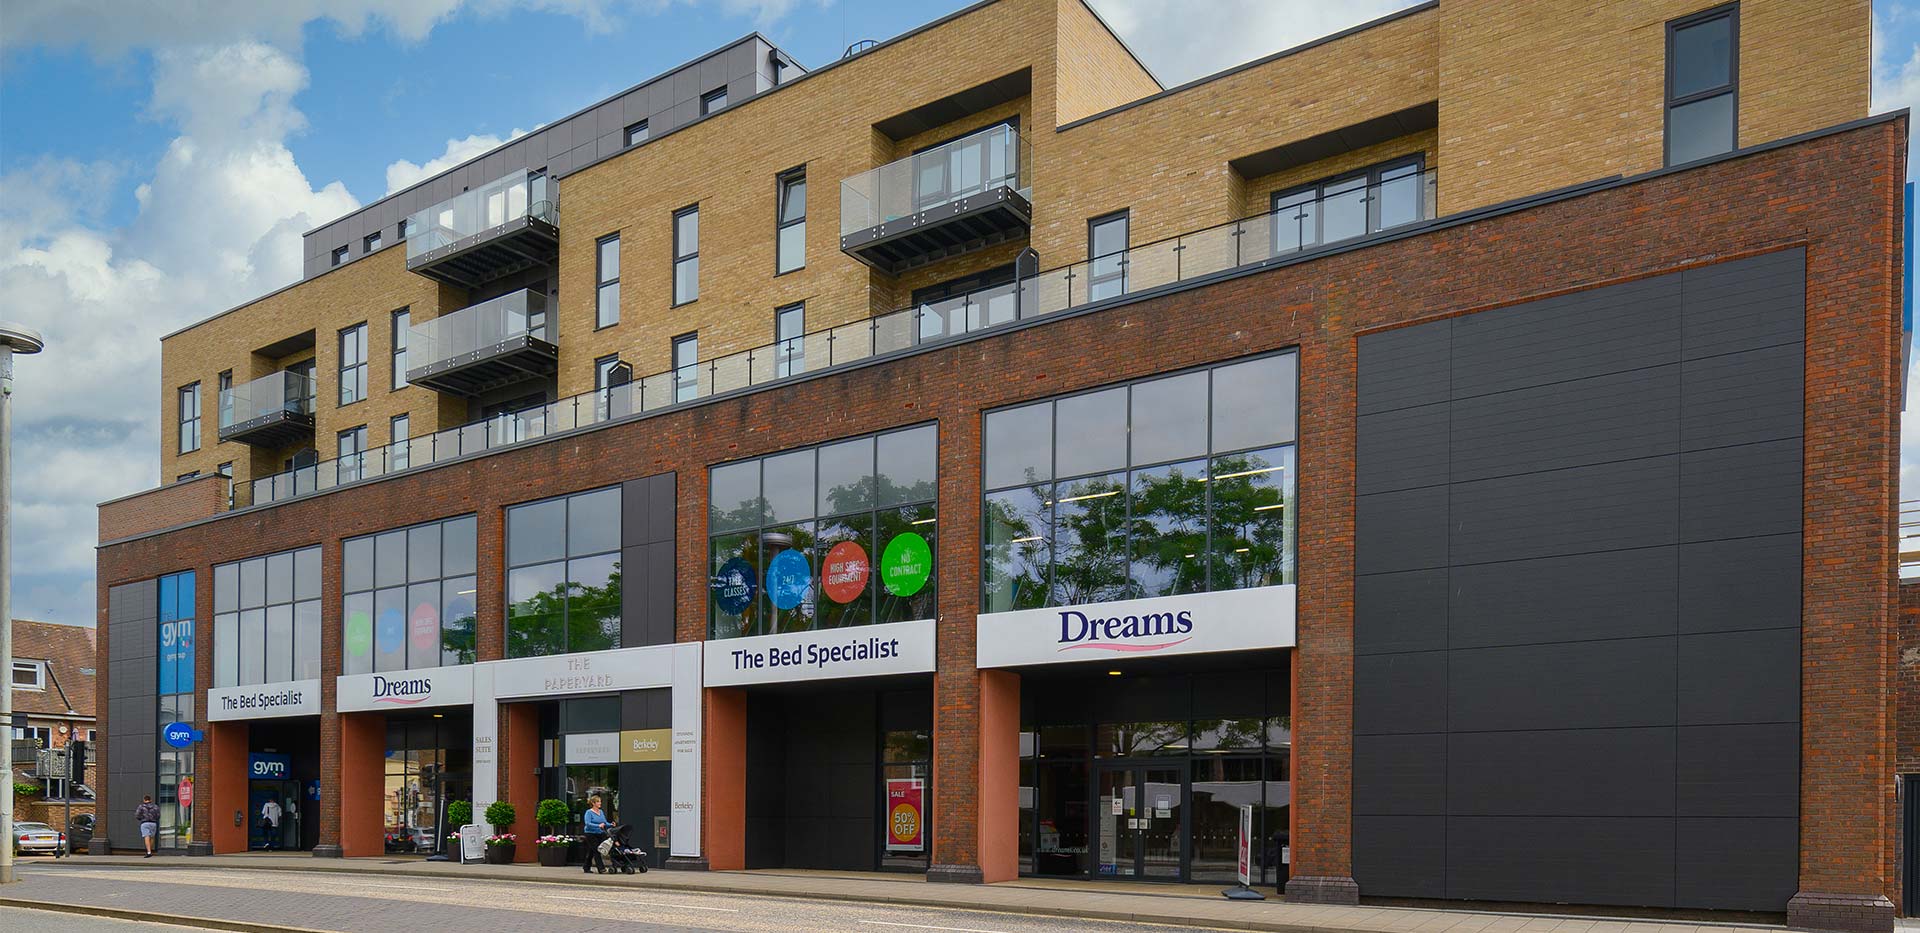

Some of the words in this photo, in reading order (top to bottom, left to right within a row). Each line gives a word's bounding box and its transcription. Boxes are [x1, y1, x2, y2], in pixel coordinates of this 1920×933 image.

[830, 562, 844, 574] HIGH
[889, 564, 922, 577] CONTRACT
[723, 586, 747, 598] CLASSES
[1058, 610, 1193, 643] Dreams
[162, 620, 191, 647] gym
[731, 650, 764, 670] The
[769, 644, 802, 667] Bed
[807, 637, 899, 668] Specialist
[567, 657, 591, 671] THE
[373, 676, 432, 697] Dreams
[544, 673, 613, 690] PAPERYARD
[221, 696, 238, 710] The
[240, 693, 257, 709] Bed
[258, 690, 303, 710] Specialist
[169, 731, 190, 740] gym
[475, 736, 492, 744] SALES
[633, 739, 659, 752] Berkeley
[253, 761, 285, 775] gym
[674, 802, 694, 812] Berkeley
[894, 812, 915, 824] 50%
[894, 824, 915, 835] OFF
